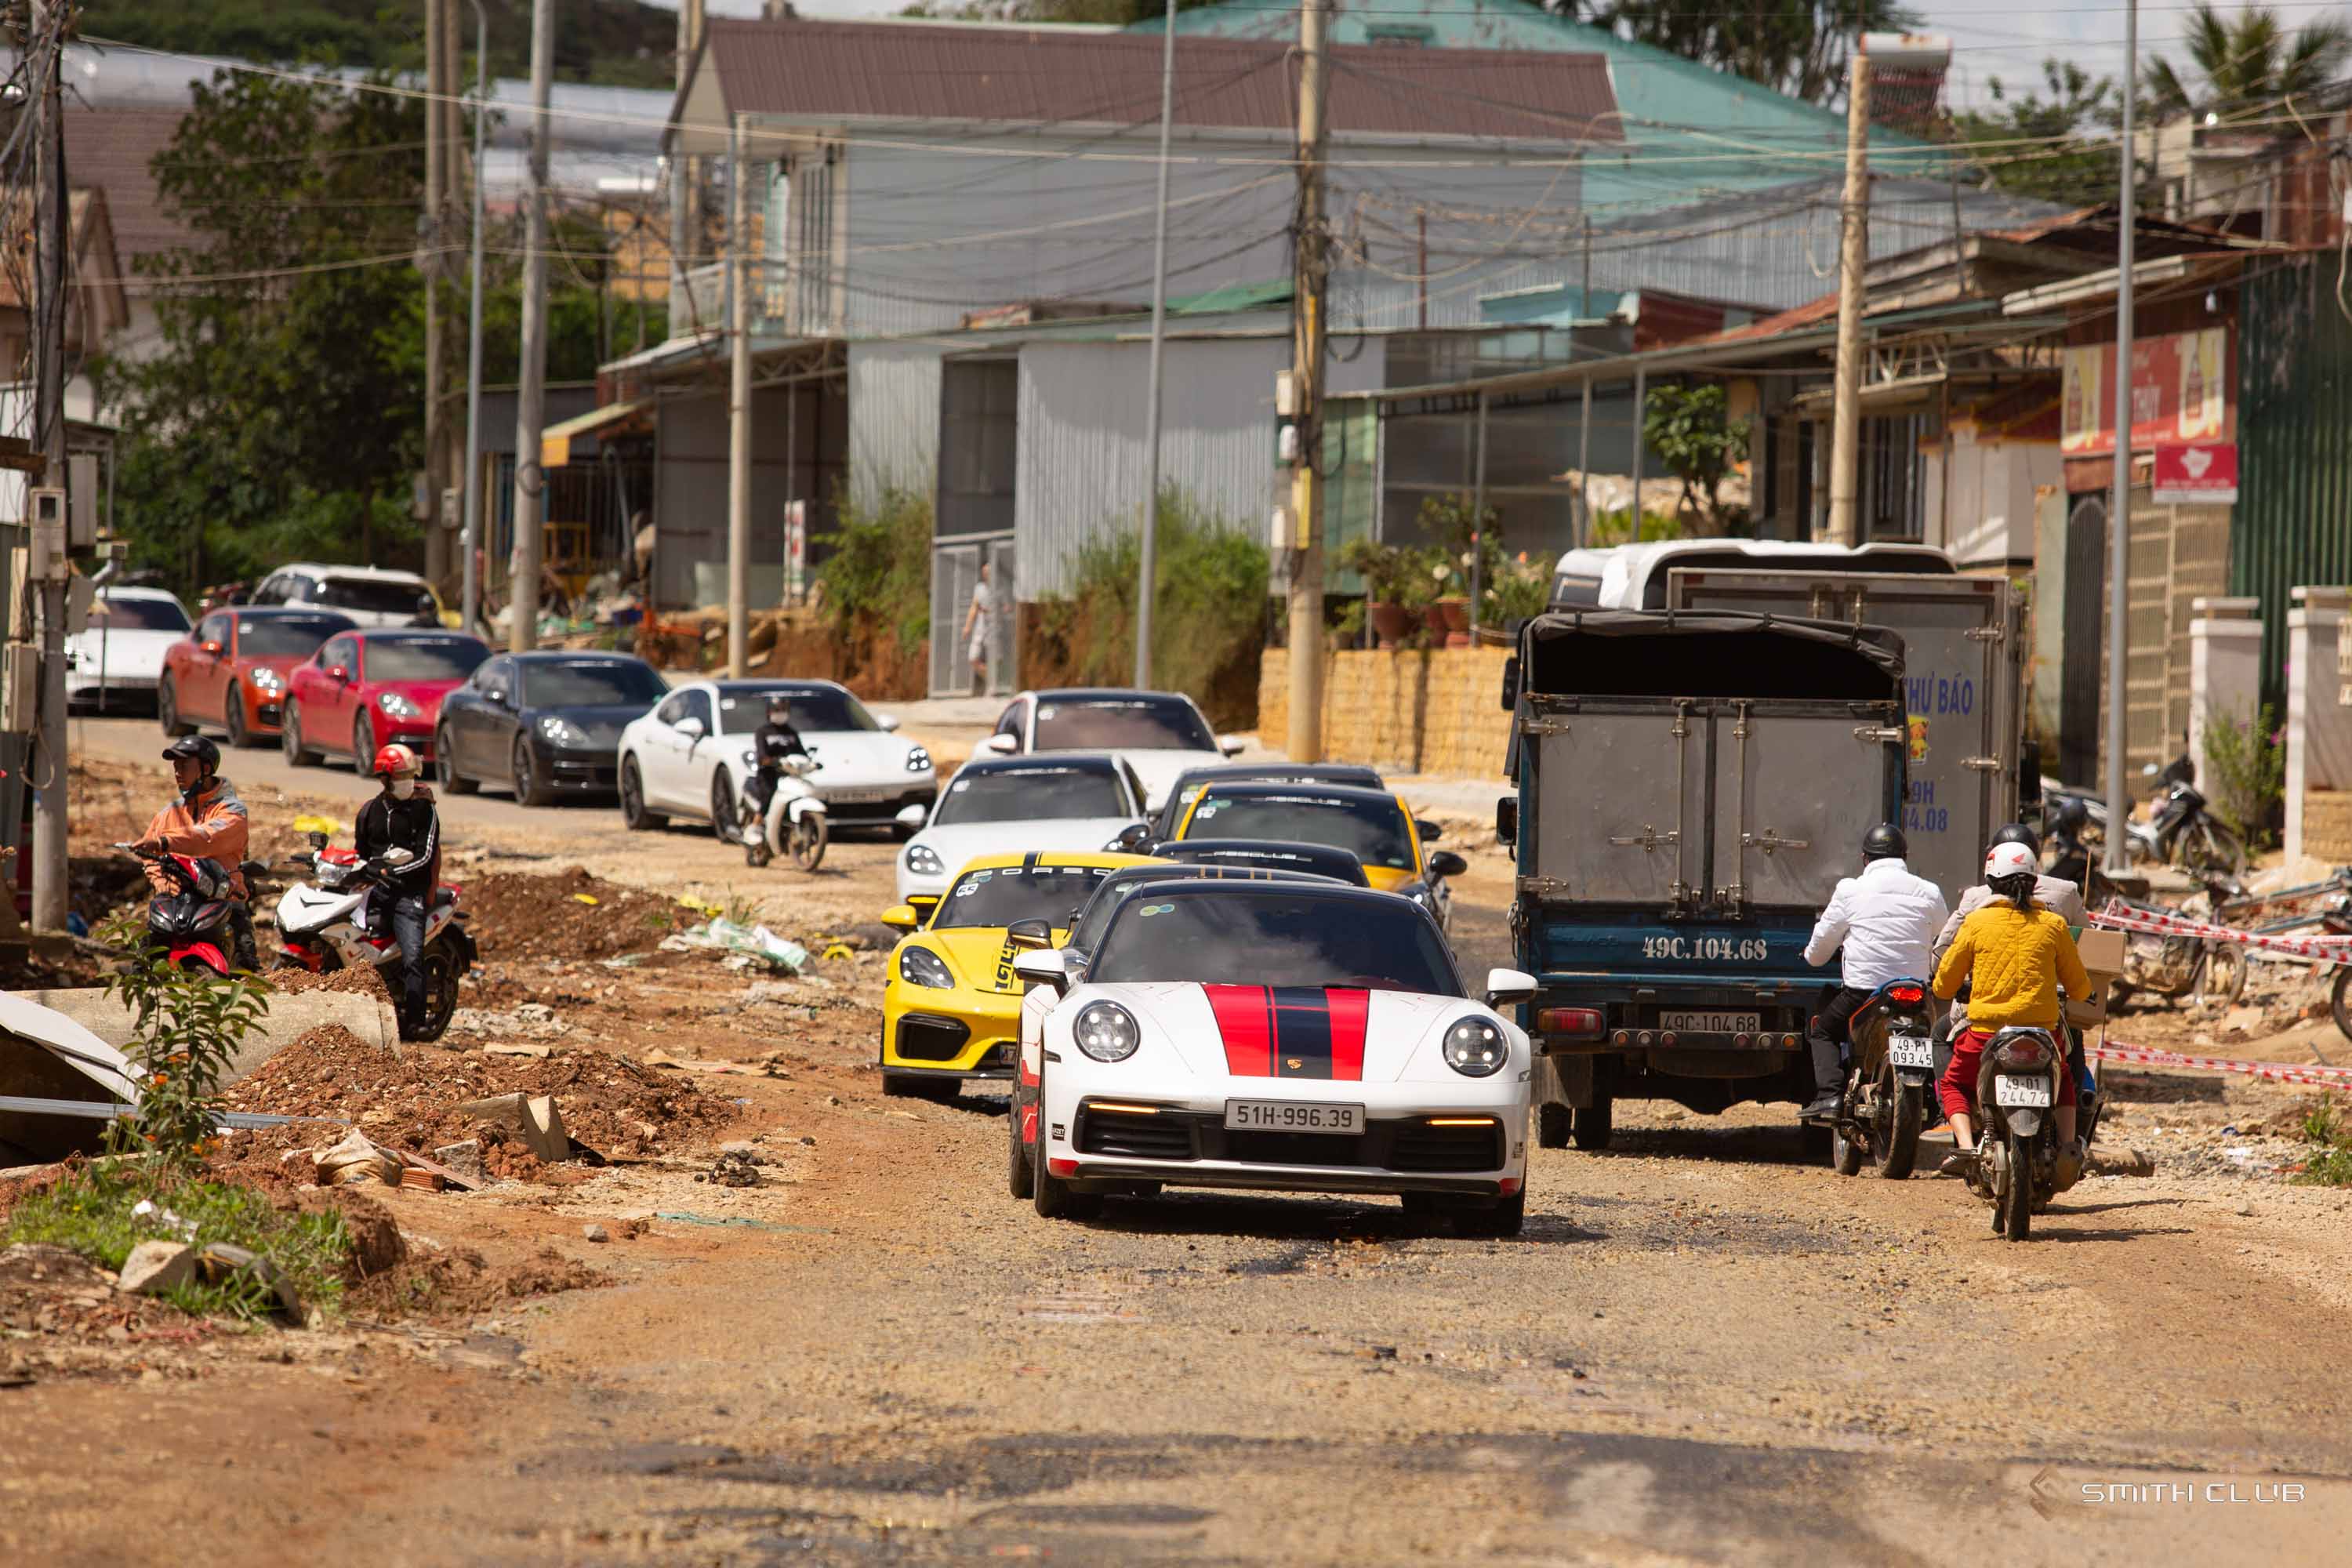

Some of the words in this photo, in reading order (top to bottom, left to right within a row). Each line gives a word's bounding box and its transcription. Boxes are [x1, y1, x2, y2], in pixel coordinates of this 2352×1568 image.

[1904, 671, 1935, 713] HƯ
[1938, 672, 1973, 715] BÁO
[1904, 808, 1948, 832] 4.08
[1642, 936, 1768, 960] 49C.104.68
[1897, 1039, 1927, 1052] 49-P1
[1236, 1105, 1353, 1128] 51H-996.39
